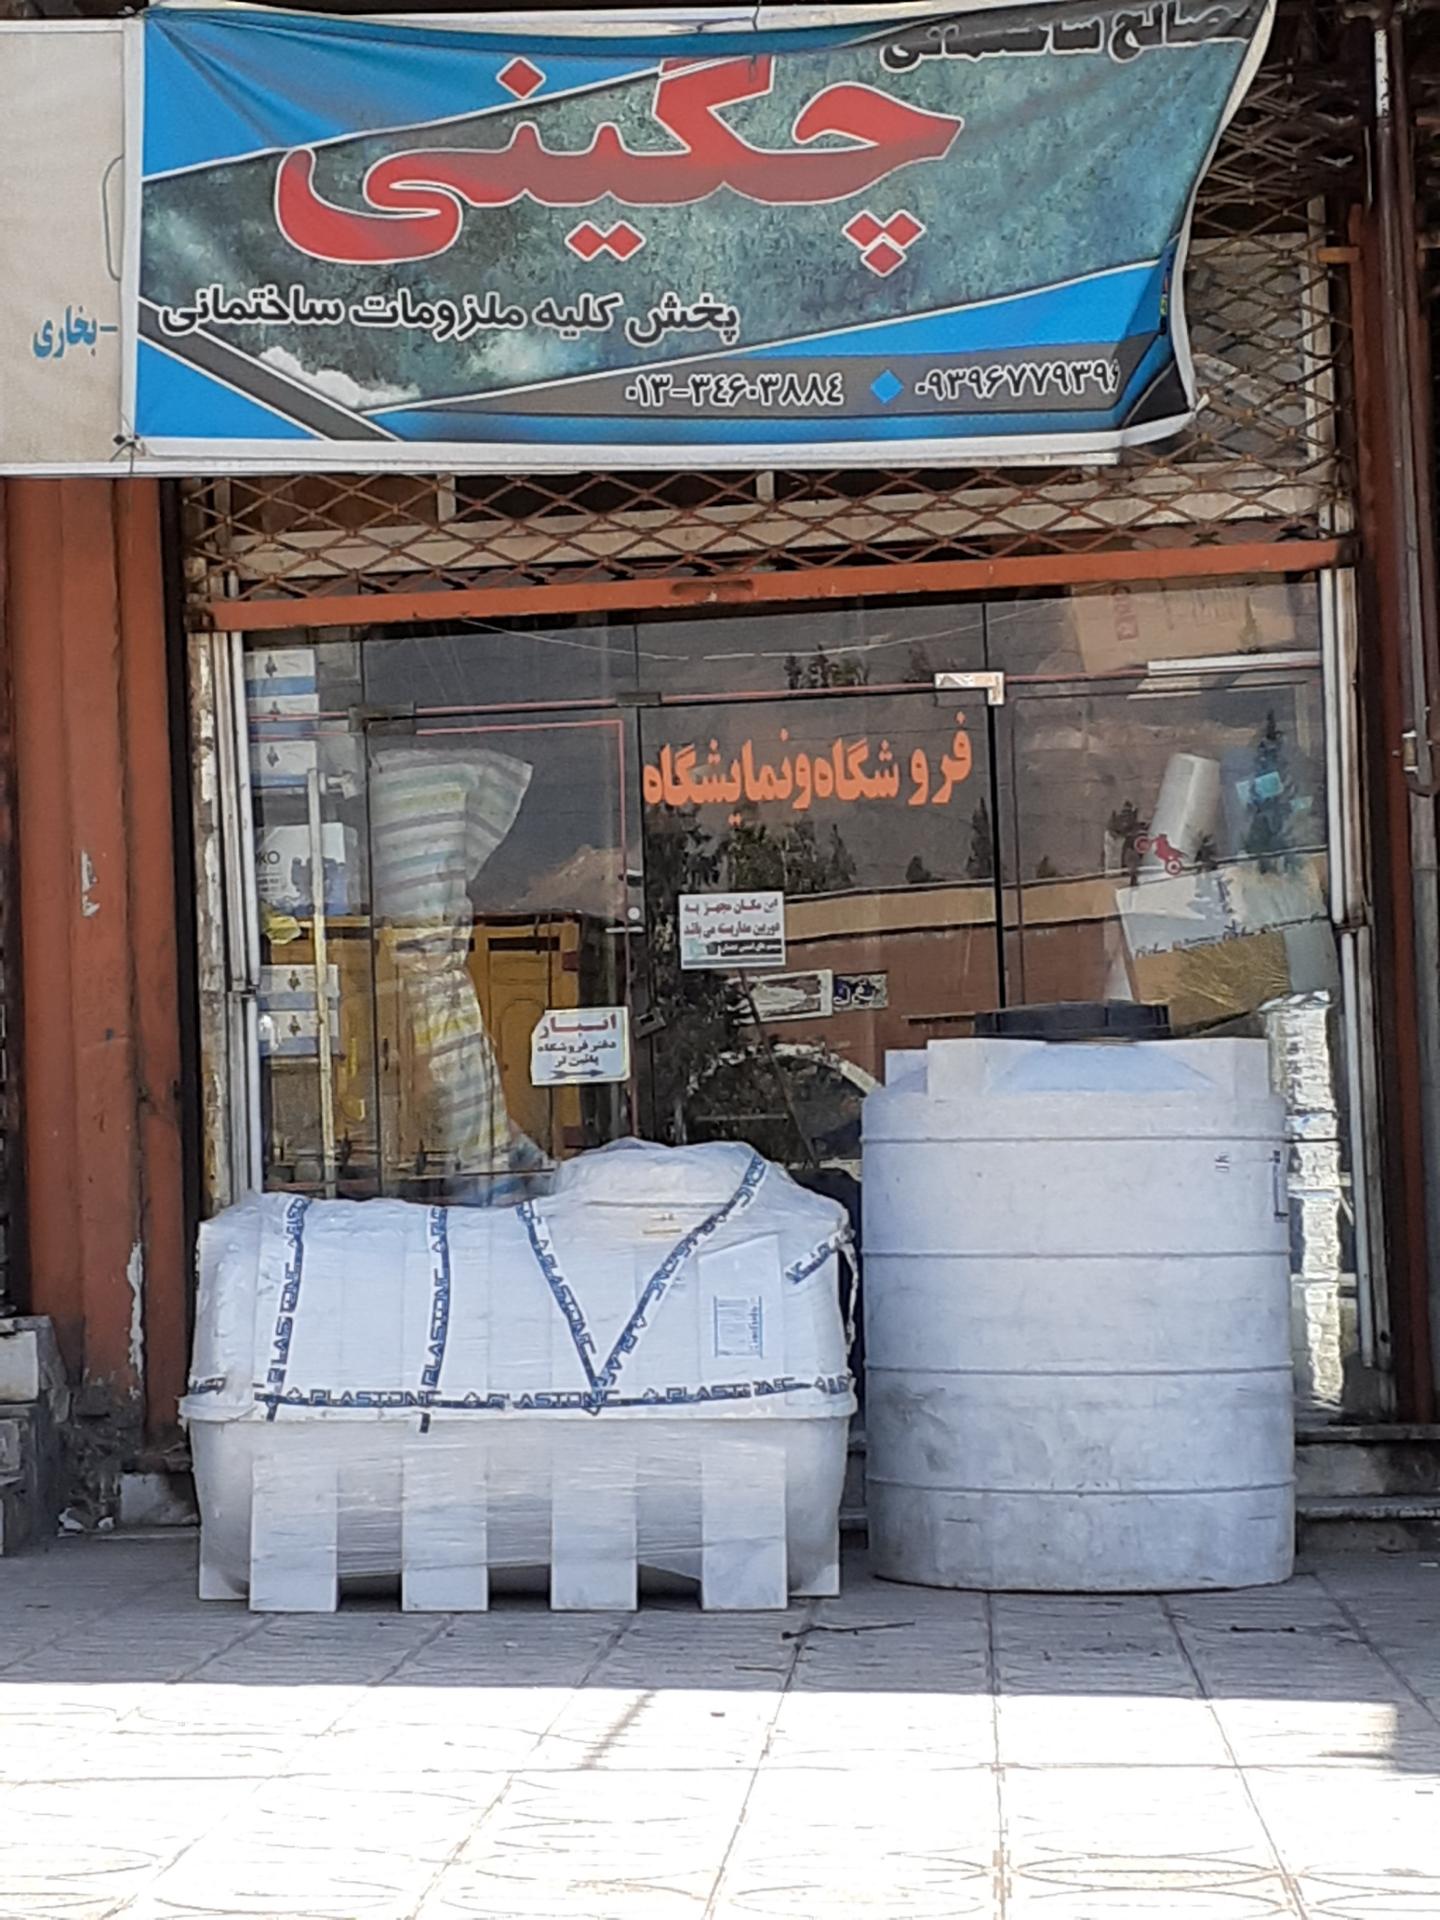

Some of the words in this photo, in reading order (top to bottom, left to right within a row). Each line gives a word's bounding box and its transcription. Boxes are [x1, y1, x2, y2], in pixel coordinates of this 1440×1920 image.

[275, 57, 963, 276] چکینی
[159, 284, 346, 337] ساختمانی
[350, 287, 527, 341] ملزومات
[532, 291, 625, 338] کلیه
[625, 291, 741, 346] پخش
[537, 1040, 589, 1054] فروشگاه
[539, 1013, 617, 1039] انبار
[589, 1039, 617, 1053] دفتر
